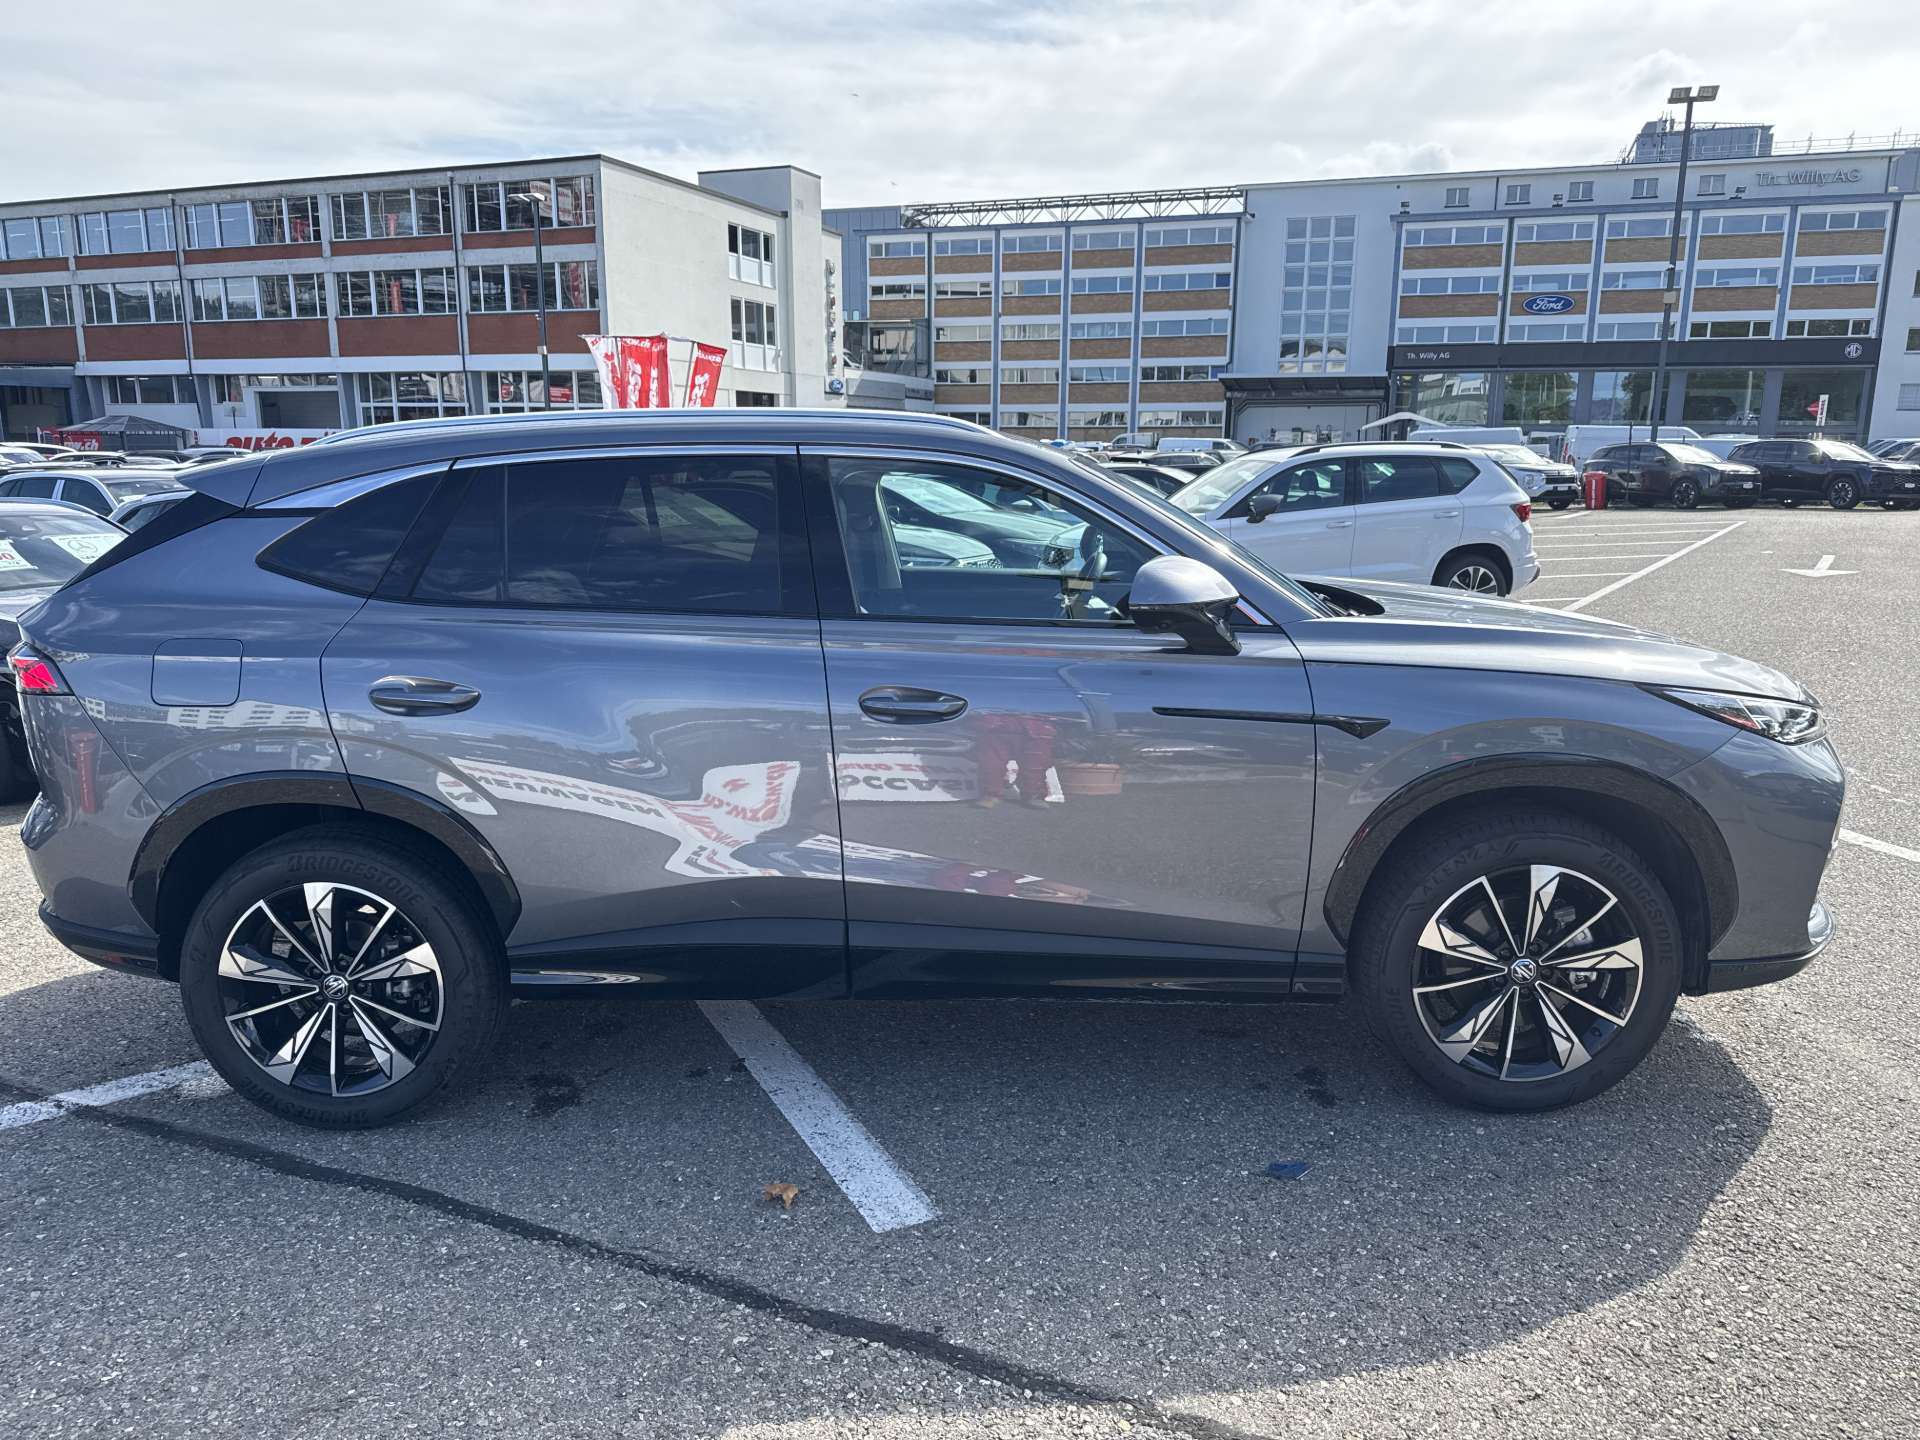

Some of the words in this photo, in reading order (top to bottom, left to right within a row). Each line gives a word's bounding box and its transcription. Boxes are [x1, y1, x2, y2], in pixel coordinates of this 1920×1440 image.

[1788, 169, 1825, 187] Willy
[1834, 168, 1861, 183] AG
[1419, 352, 1438, 361] Willy
[1439, 352, 1450, 360] AG
[1845, 343, 1862, 358] MG
[286, 854, 425, 906] BRIDGESTONE
